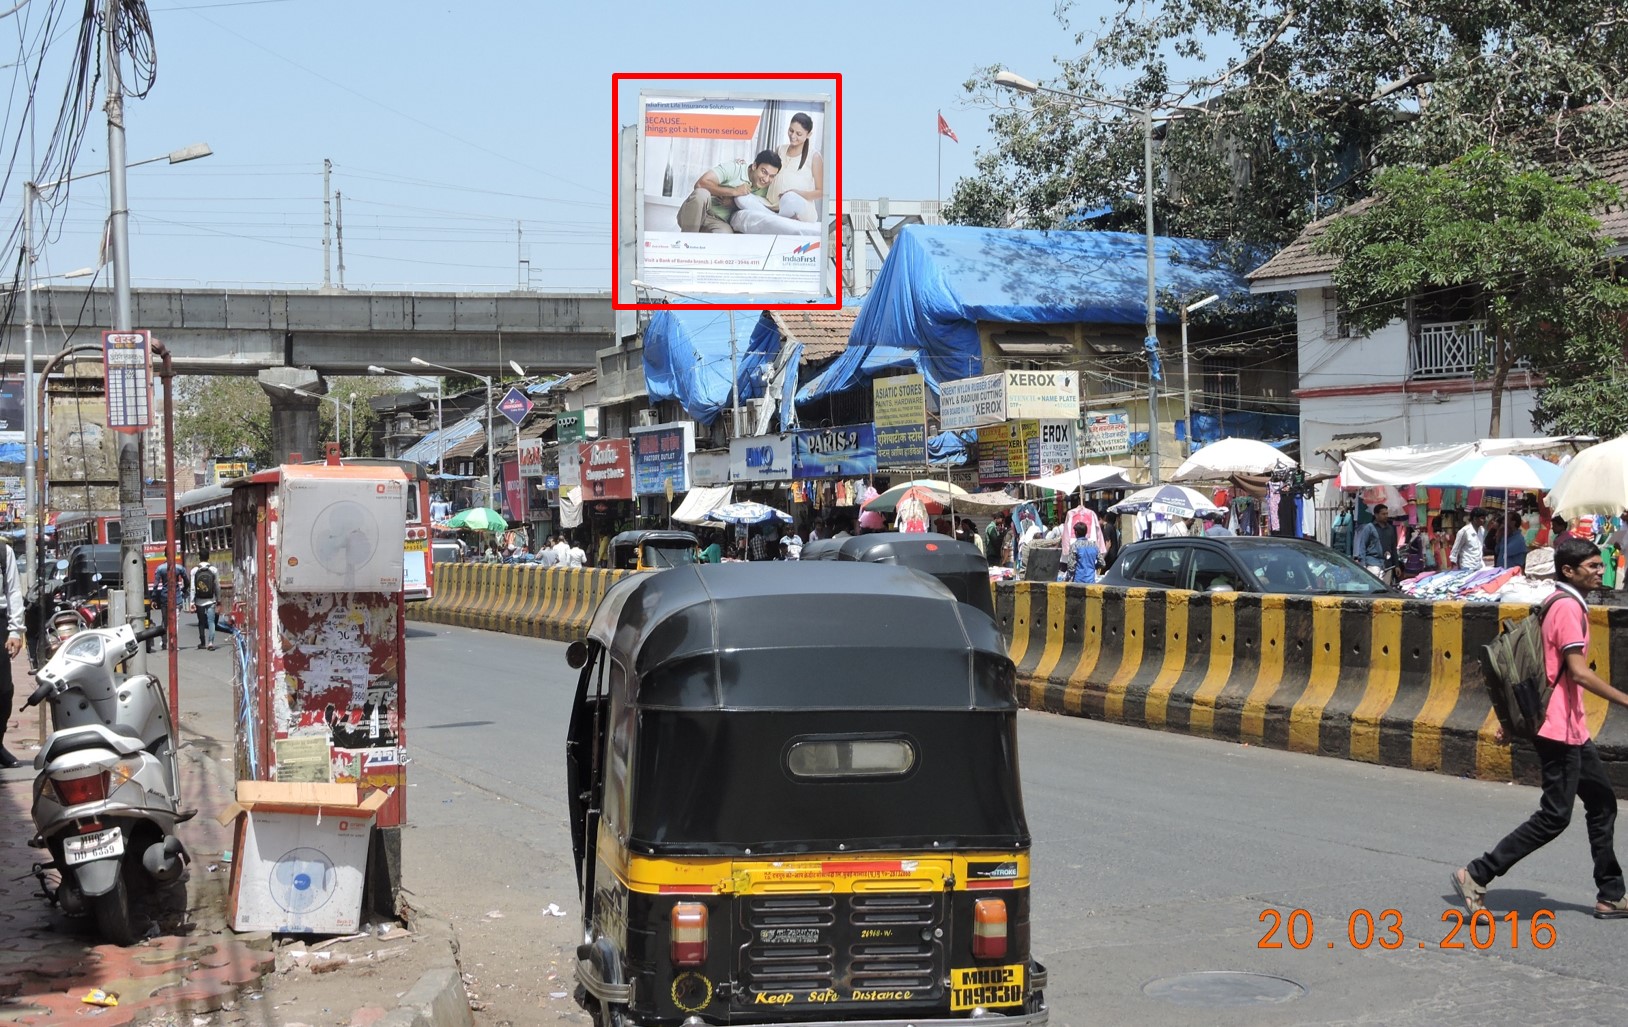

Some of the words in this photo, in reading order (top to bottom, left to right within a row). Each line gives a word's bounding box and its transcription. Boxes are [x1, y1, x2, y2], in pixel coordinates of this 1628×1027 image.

[681, 103, 709, 111] Insurance
[668, 126, 682, 135] got
[688, 126, 699, 134] bit
[721, 127, 748, 136] serious
[782, 255, 816, 263] IndiaFirst
[1009, 373, 1056, 387] XEROX
[875, 386, 898, 400] ASIATIC
[899, 383, 922, 398] STORES
[960, 392, 980, 404] RADIUM
[980, 388, 1003, 400] CUTTING
[894, 396, 923, 406] HARDWARE
[975, 399, 1002, 416] XEROX
[958, 414, 976, 425] PLATE
[808, 431, 859, 454] PARIS-2
[643, 454, 660, 462] FACTORY
[660, 452, 675, 461] OUTLET
[63, 764, 91, 774] HONDA
[74, 851, 88, 862] DD
[92, 845, 115, 858] 6359
[990, 867, 1017, 877] STROKE
[754, 991, 795, 1007] Keep
[807, 988, 841, 1005] Safe
[851, 989, 913, 1002] Distance
[953, 984, 1022, 1007] TA9330
